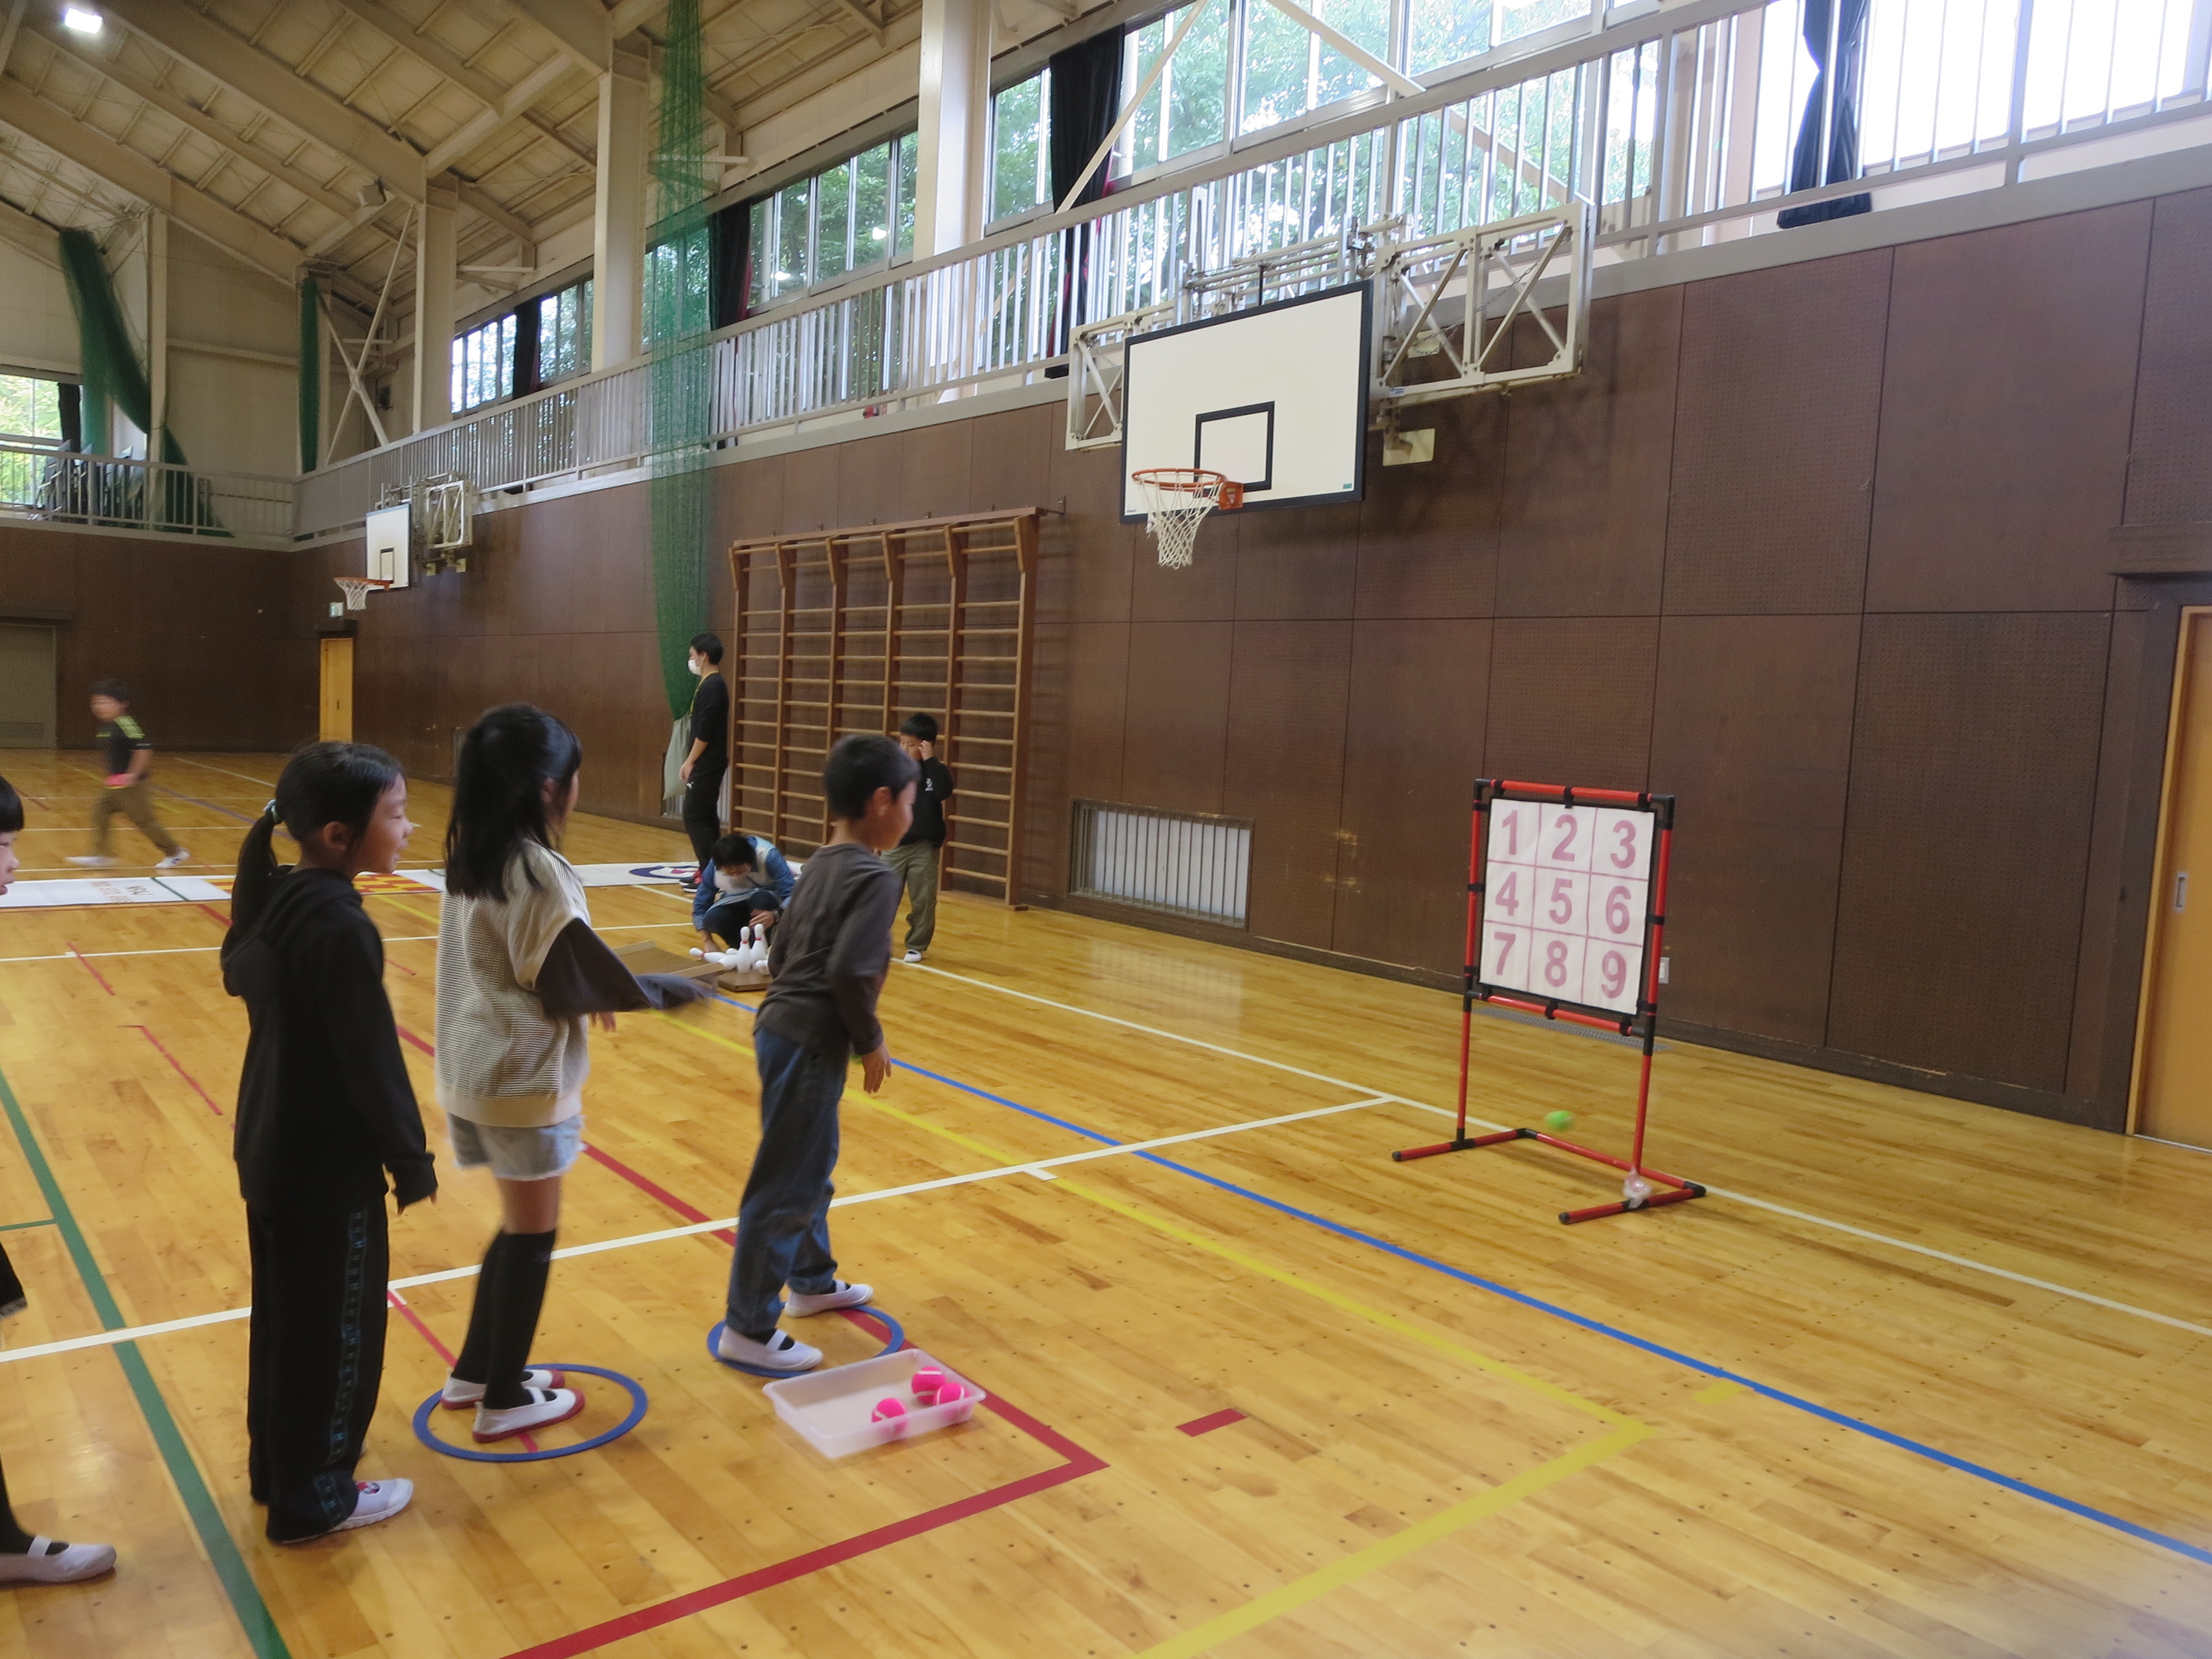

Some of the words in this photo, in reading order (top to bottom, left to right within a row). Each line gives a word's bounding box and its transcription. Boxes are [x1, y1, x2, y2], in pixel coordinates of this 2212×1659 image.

[1502, 810, 1518, 854] 1
[1552, 815, 1578, 861] 2
[1610, 820, 1636, 869] 3
[1495, 872, 1519, 916] 4
[1550, 878, 1573, 925] 5
[1606, 886, 1631, 934] 6
[1494, 932, 1516, 975] 7
[1545, 940, 1568, 987] 8
[1601, 951, 1627, 999] 9
